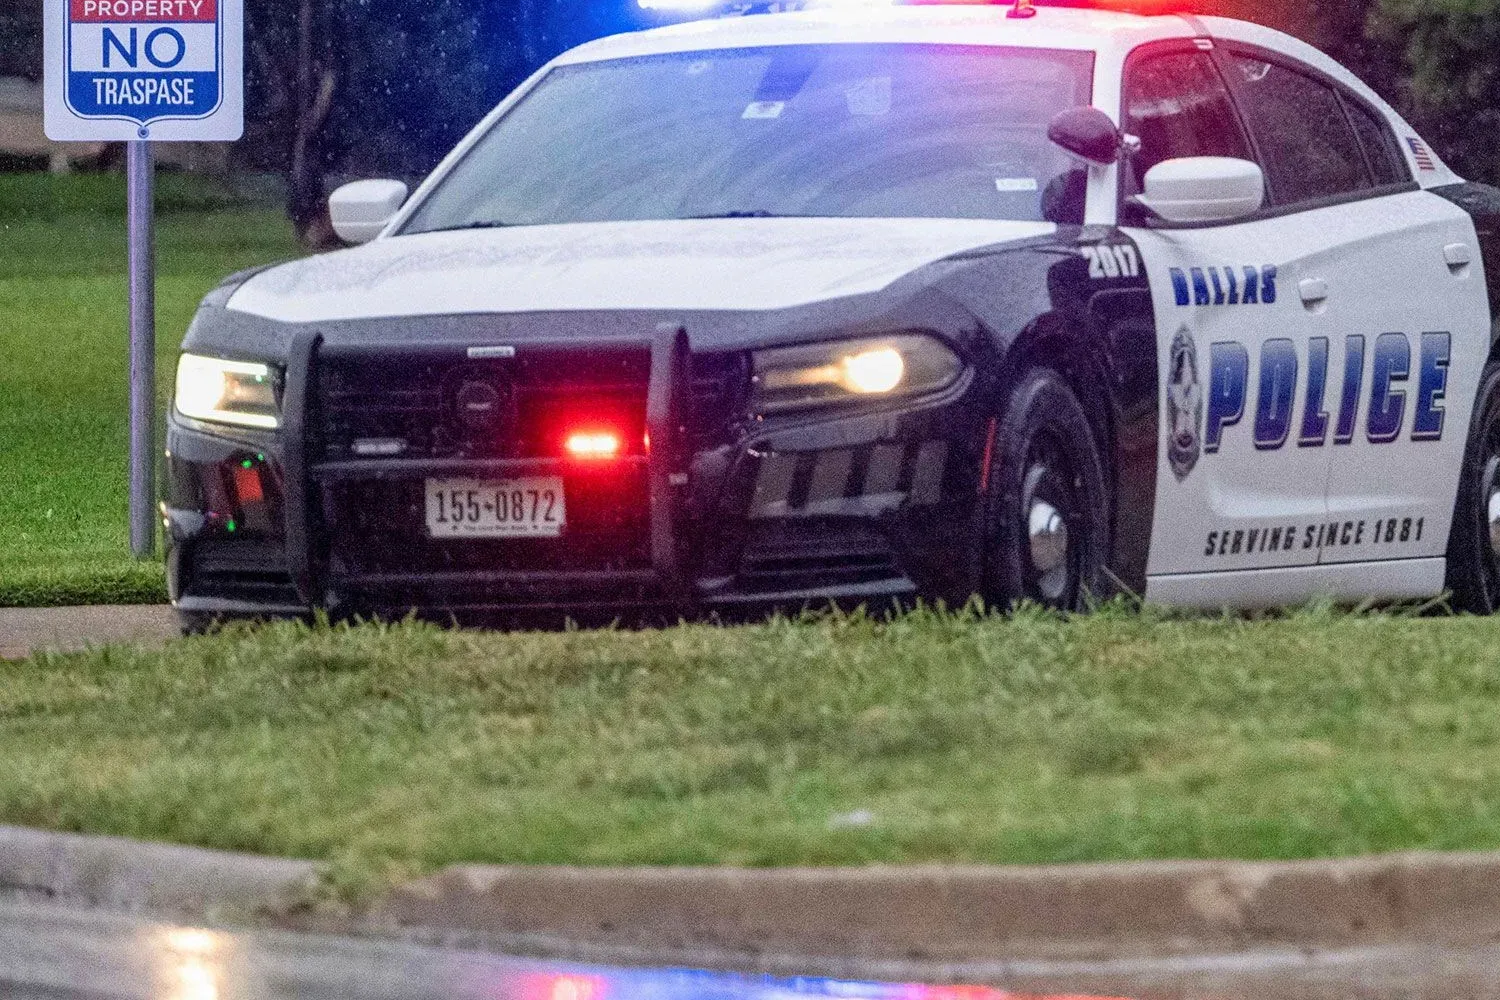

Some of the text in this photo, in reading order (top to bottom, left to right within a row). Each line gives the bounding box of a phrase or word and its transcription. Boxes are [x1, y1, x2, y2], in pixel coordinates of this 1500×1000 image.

[84, 0, 203, 17] PROPERTY
[102, 26, 186, 69] NO
[92, 78, 194, 105] TRASPASE
[1082, 245, 1139, 279] 2017
[1169, 264, 1277, 306] DALLAS
[1204, 331, 1452, 454] POLICE
[1205, 517, 1424, 556] SERVING SINCE 1881
